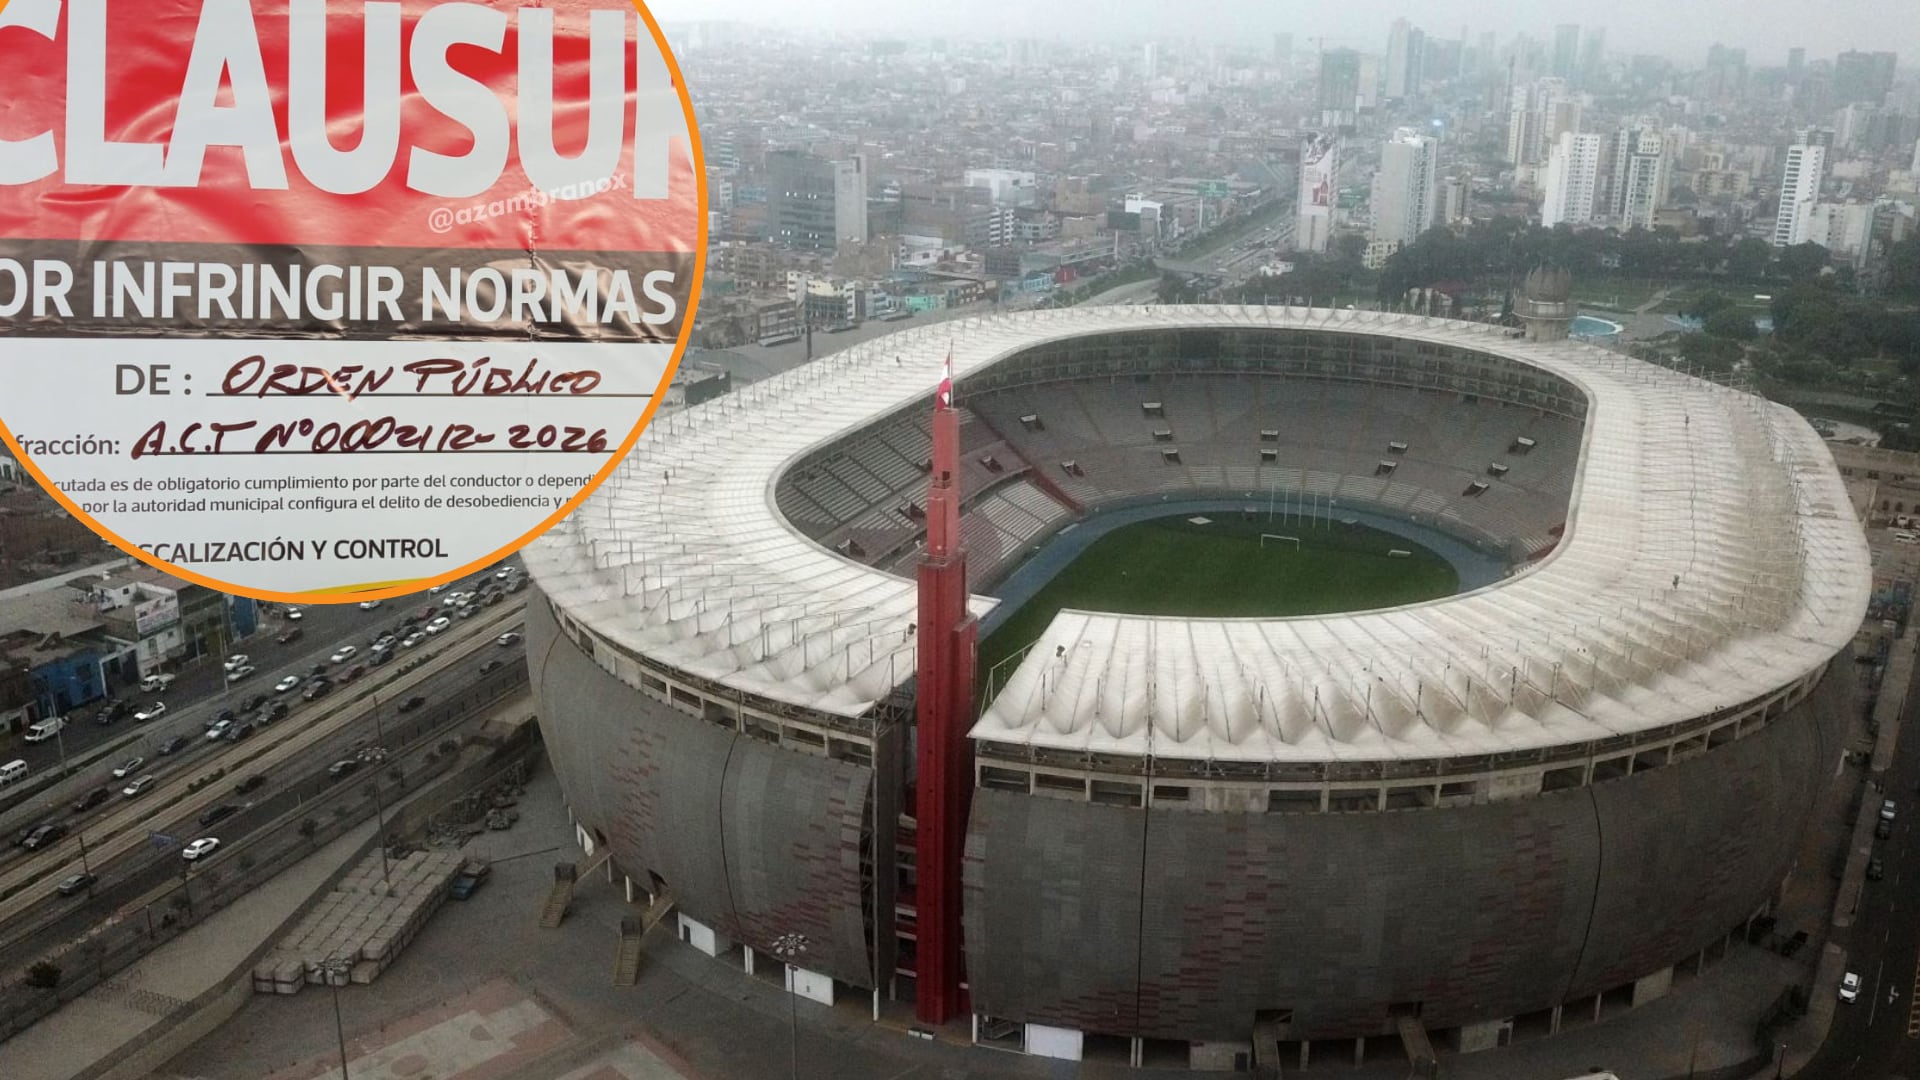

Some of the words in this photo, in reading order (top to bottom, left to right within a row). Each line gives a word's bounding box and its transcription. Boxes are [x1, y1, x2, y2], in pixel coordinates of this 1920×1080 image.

[93, 261, 404, 321] INFRINGIR
[422, 266, 677, 325] NORMAS
[116, 364, 171, 396] DE
[222, 355, 394, 402] ORDEN
[403, 356, 602, 397] PÚBLICO
[110, 480, 129, 492] es
[133, 477, 153, 491] de
[157, 476, 241, 494] obligatorio
[244, 475, 349, 493] cumplimiento
[352, 477, 378, 492] por
[381, 476, 420, 491] parte
[423, 474, 446, 489] del
[449, 474, 522, 489] conductor
[525, 477, 534, 488] o
[537, 473, 595, 490] depend
[113, 499, 127, 513] la
[131, 498, 206, 513] autoridad
[210, 497, 284, 514] municipal
[287, 496, 358, 513] configura
[361, 495, 375, 510] el
[378, 495, 420, 510] delito
[423, 495, 443, 509] de
[446, 494, 550, 509] desobediencia
[553, 496, 562, 509] y
[310, 540, 328, 561] Y
[333, 538, 449, 560] CONTROL
